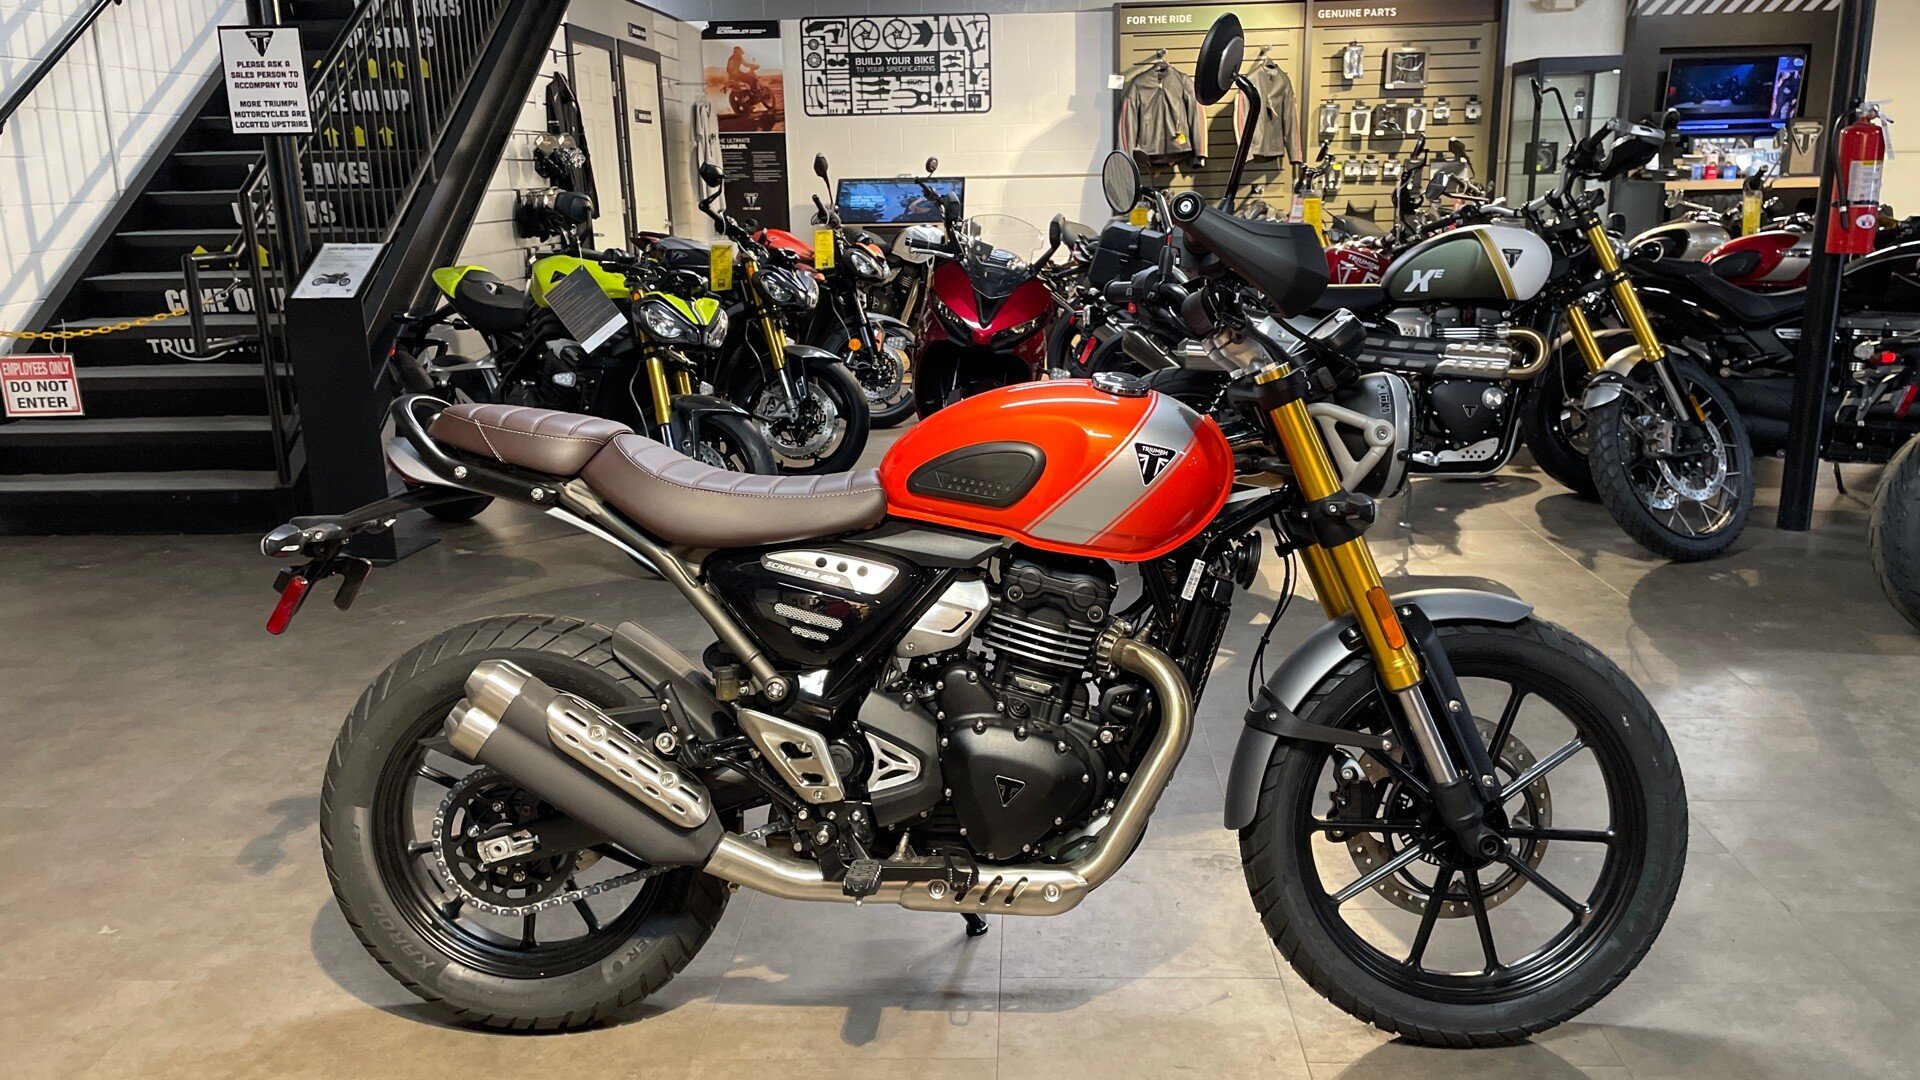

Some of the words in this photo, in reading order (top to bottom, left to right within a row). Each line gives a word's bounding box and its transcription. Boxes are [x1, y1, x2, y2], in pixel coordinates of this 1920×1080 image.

[1317, 9, 1362, 19] GENUINE
[1363, 8, 1397, 17] PARTS
[1126, 16, 1146, 25] FOR
[1148, 15, 1168, 24] THE
[1169, 14, 1193, 24] RIDE
[285, 60, 291, 68] A
[855, 57, 882, 66] BUILD
[885, 56, 911, 65] YOUR
[914, 55, 936, 65] BIKE
[886, 65, 936, 73] SPECIFICATIONS
[230, 71, 255, 79] SALES
[283, 81, 298, 89] YOU
[240, 100, 262, 108] MORE
[234, 110, 289, 118] MOTORCYCLES
[291, 110, 307, 118] ARE
[235, 121, 270, 129] LOCATED
[271, 120, 309, 128] UPSTAIRS
[312, 161, 370, 186] BIKES
[1, 362, 48, 376] EMPLOYEES
[49, 361, 70, 375] ONLY
[10, 381, 32, 393] DO
[36, 380, 68, 392] NOT
[17, 396, 68, 409] ENTER
[1141, 445, 1169, 457] TRIUMPH
[765, 561, 820, 579] SCRAMBLER
